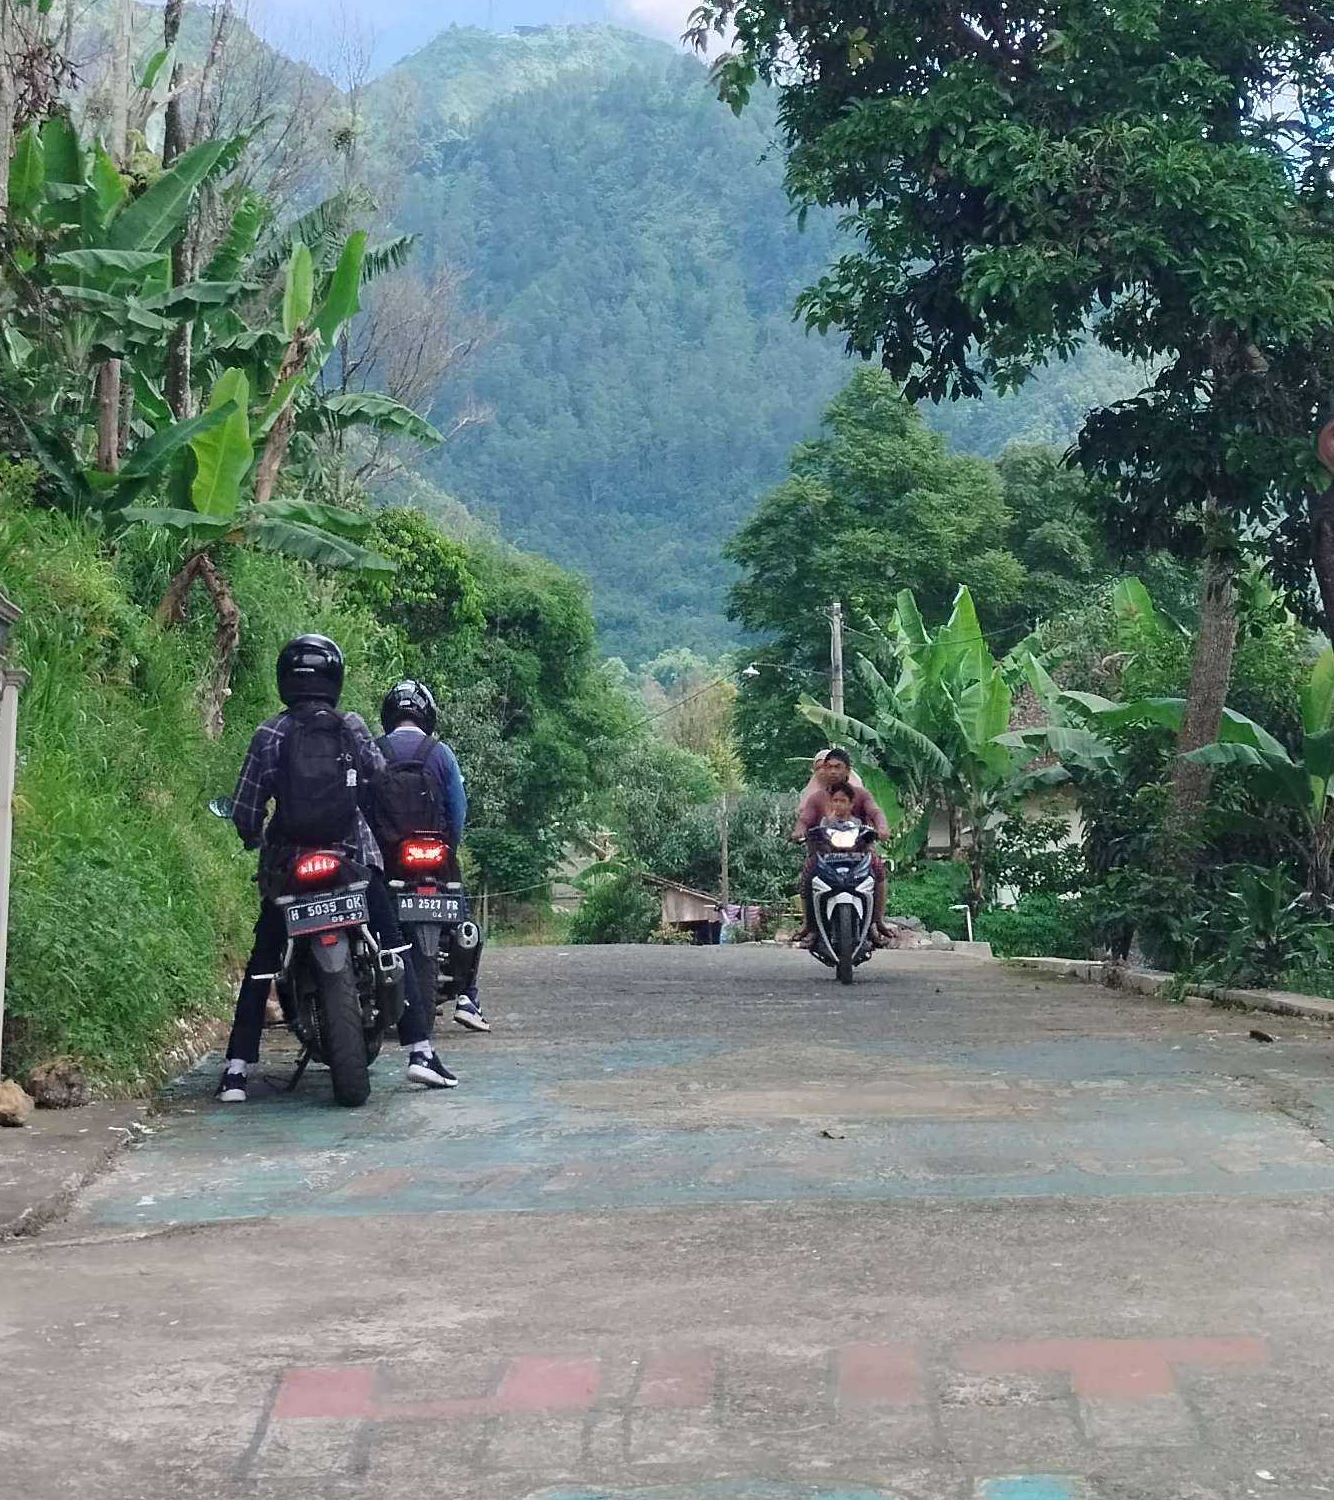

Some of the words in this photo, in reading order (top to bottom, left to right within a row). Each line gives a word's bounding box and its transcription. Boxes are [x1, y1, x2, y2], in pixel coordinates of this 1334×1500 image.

[290, 909, 300, 922] H
[307, 901, 338, 917] 5035
[346, 896, 362, 910] OK
[400, 898, 414, 909] AB
[418, 899, 442, 910] 2527
